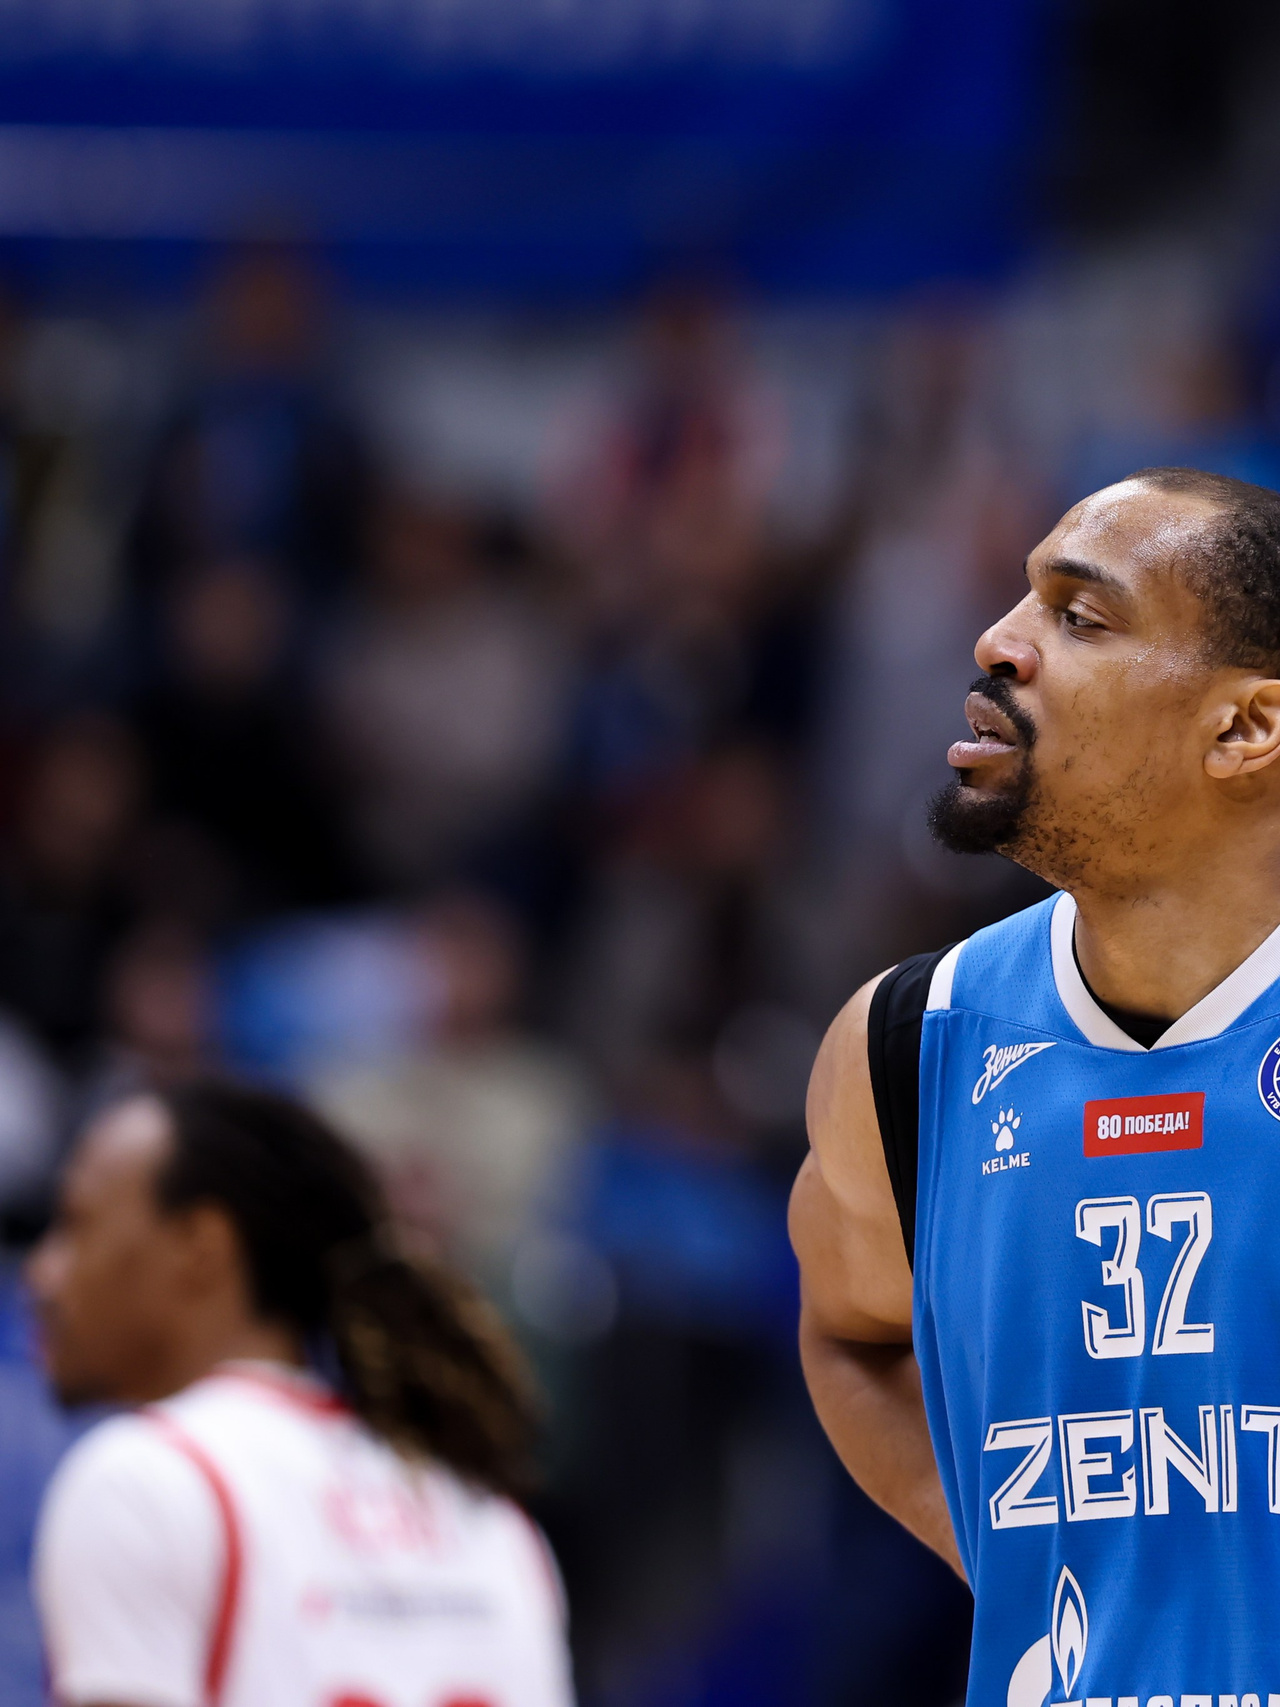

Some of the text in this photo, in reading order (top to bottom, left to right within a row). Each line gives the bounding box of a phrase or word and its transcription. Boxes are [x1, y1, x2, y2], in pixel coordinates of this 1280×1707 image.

[1266, 1091, 1280, 1109] VTB
[1097, 1111, 1190, 1140] 80 ПОБЕДА!
[982, 1152, 1031, 1176] KELME
[1075, 1191, 1214, 1360] 32
